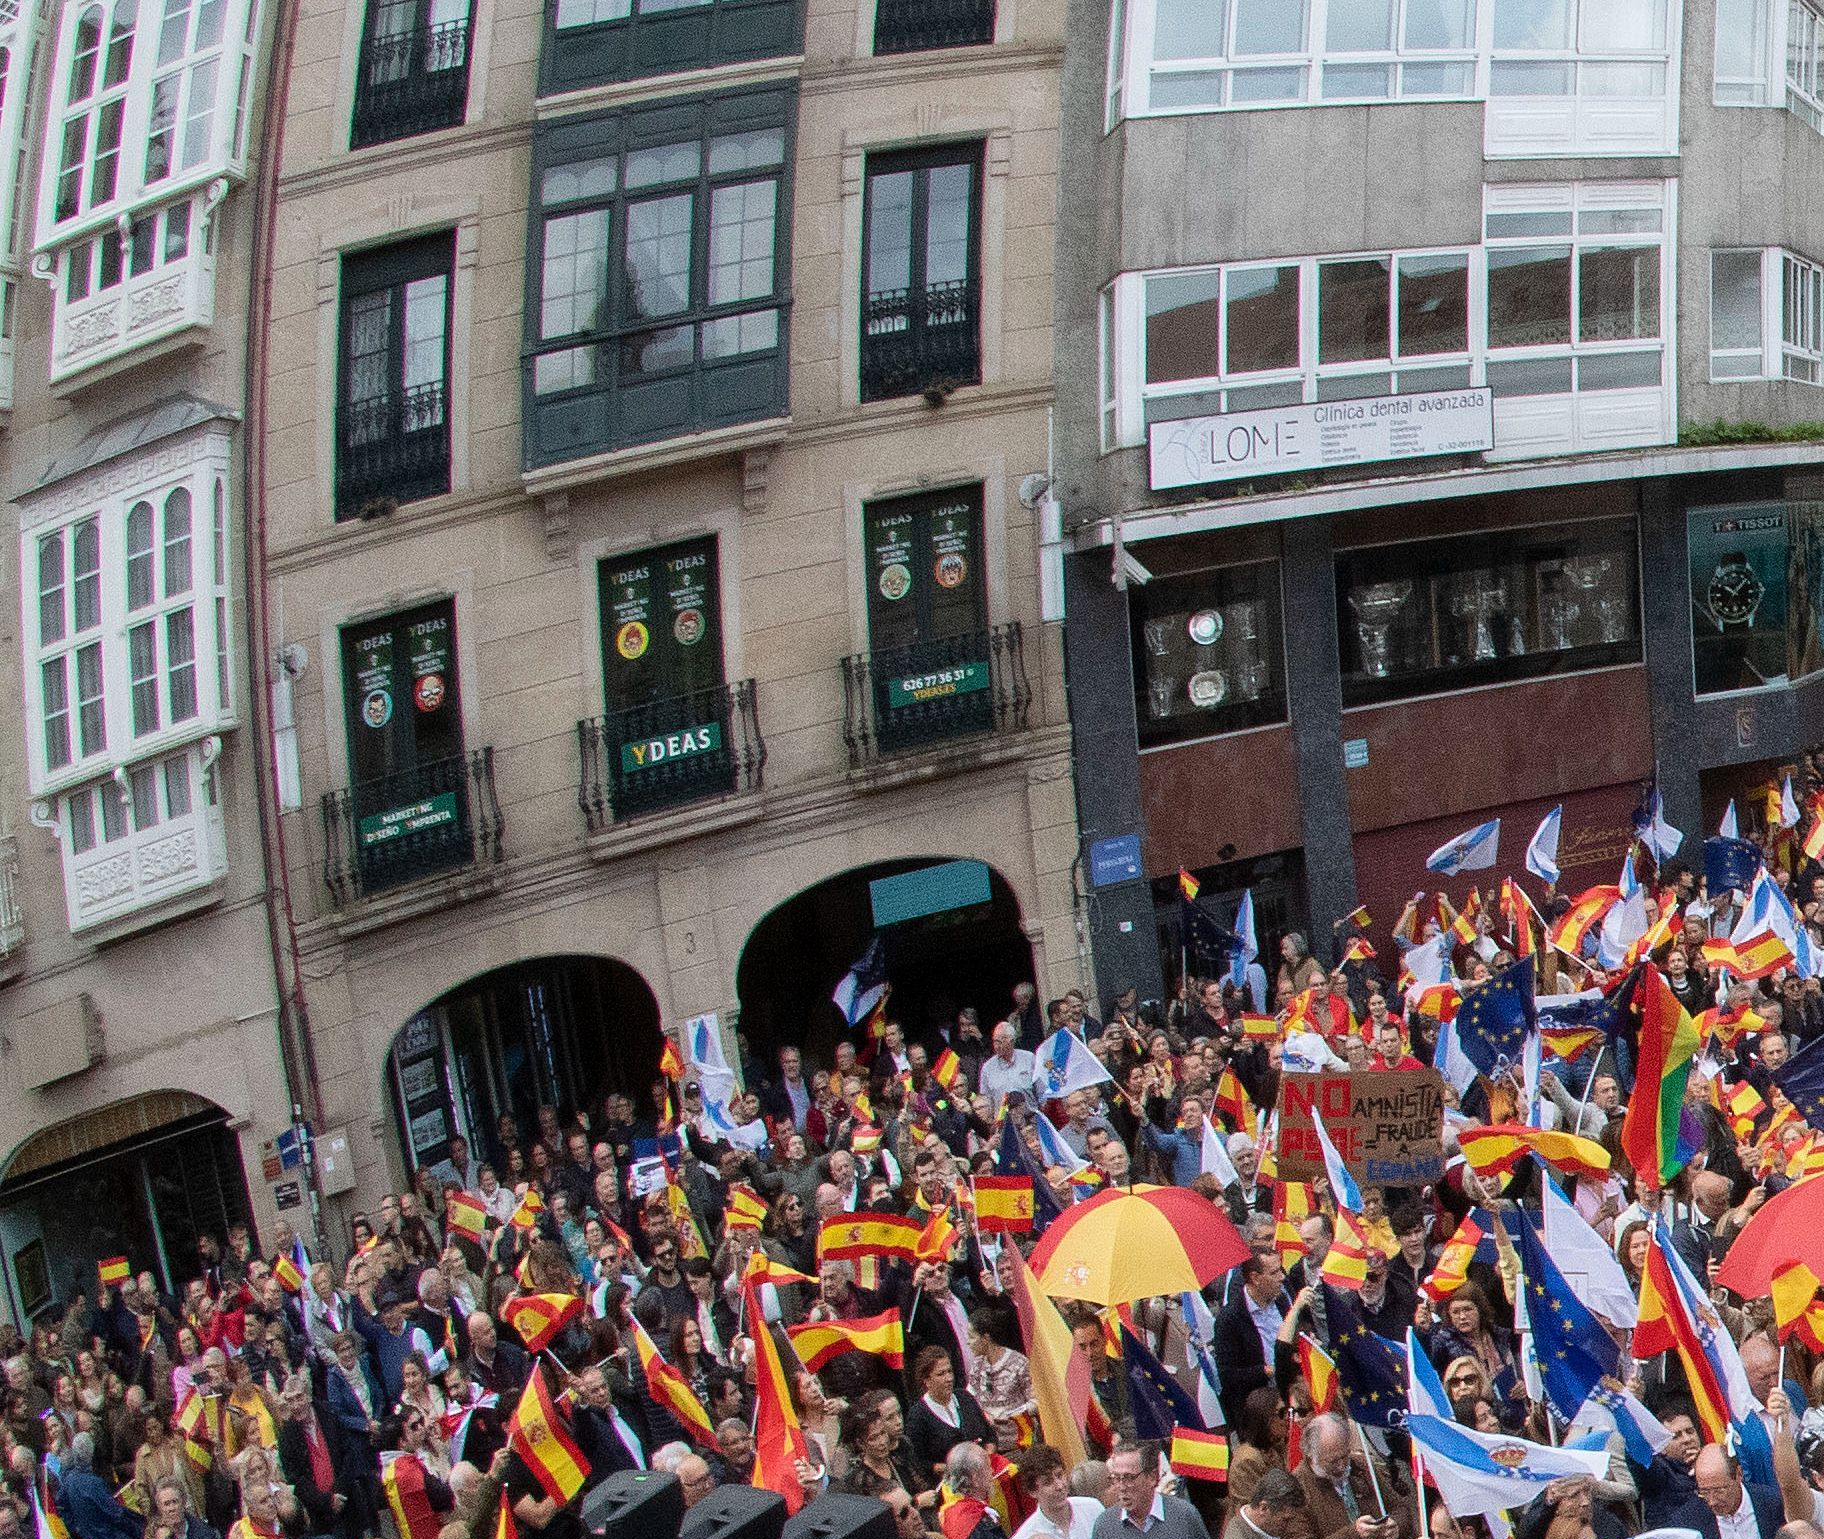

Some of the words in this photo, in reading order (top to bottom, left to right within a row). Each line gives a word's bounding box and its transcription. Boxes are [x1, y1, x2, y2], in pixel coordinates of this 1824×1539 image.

[1314, 404, 1365, 424] Clínica
[1370, 398, 1412, 417] dental
[1417, 392, 1484, 412] avanzada
[1210, 421, 1301, 465] LOME
[1738, 516, 1781, 530] TISSOT
[924, 674, 938, 687] 77
[631, 728, 712, 766] YDEAS
[684, 931, 696, 953] 3
[1283, 1077, 1352, 1120] NO
[1354, 1082, 1445, 1120] AMNISTIA
